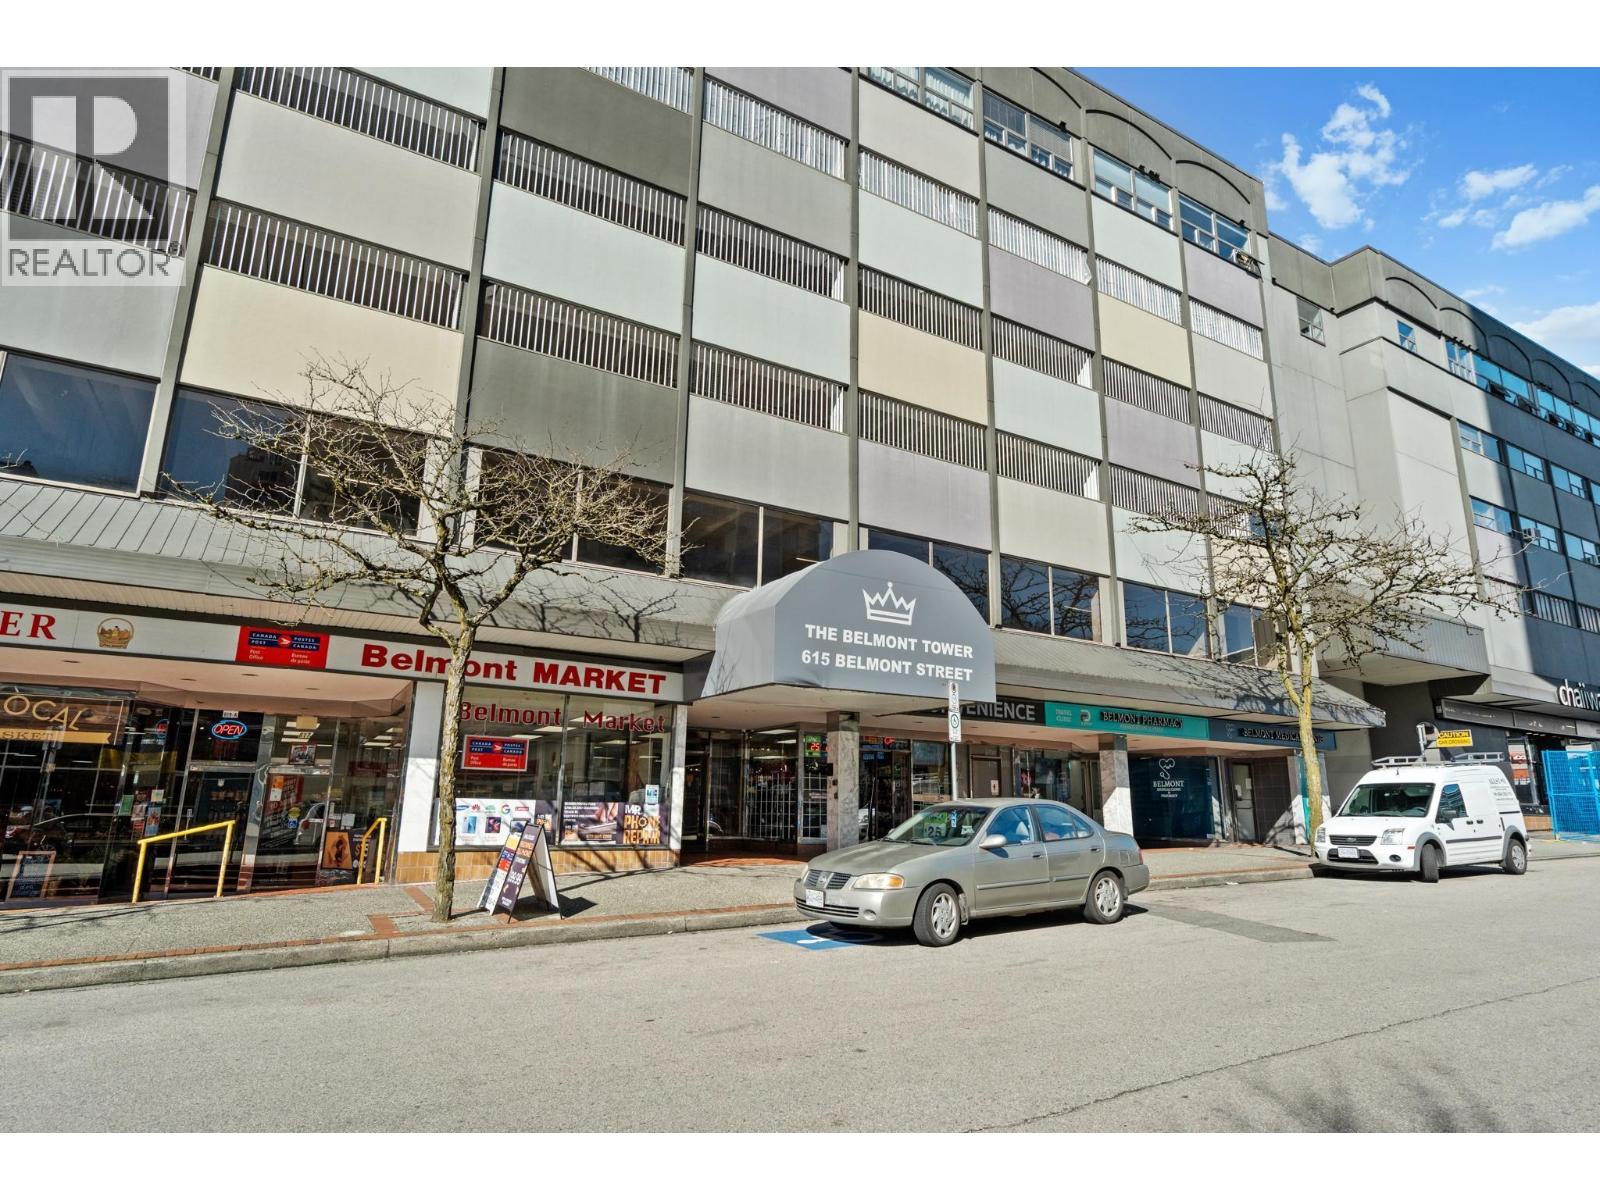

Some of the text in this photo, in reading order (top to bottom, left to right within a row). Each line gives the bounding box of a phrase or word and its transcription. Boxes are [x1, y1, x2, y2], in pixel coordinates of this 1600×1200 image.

[805, 624, 973, 658] THE BELMONT TOWER
[361, 644, 666, 694] Belmont MARKET
[802, 650, 973, 681] 615 BELMONT STREET
[460, 701, 665, 732] Belmont Market
[1103, 712, 1141, 724] BELMONT
[1143, 716, 1183, 729] PHARMACY
[214, 724, 243, 735] OPEN
[1243, 728, 1274, 739] BELMONT
[1153, 780, 1184, 788] BELMONT
